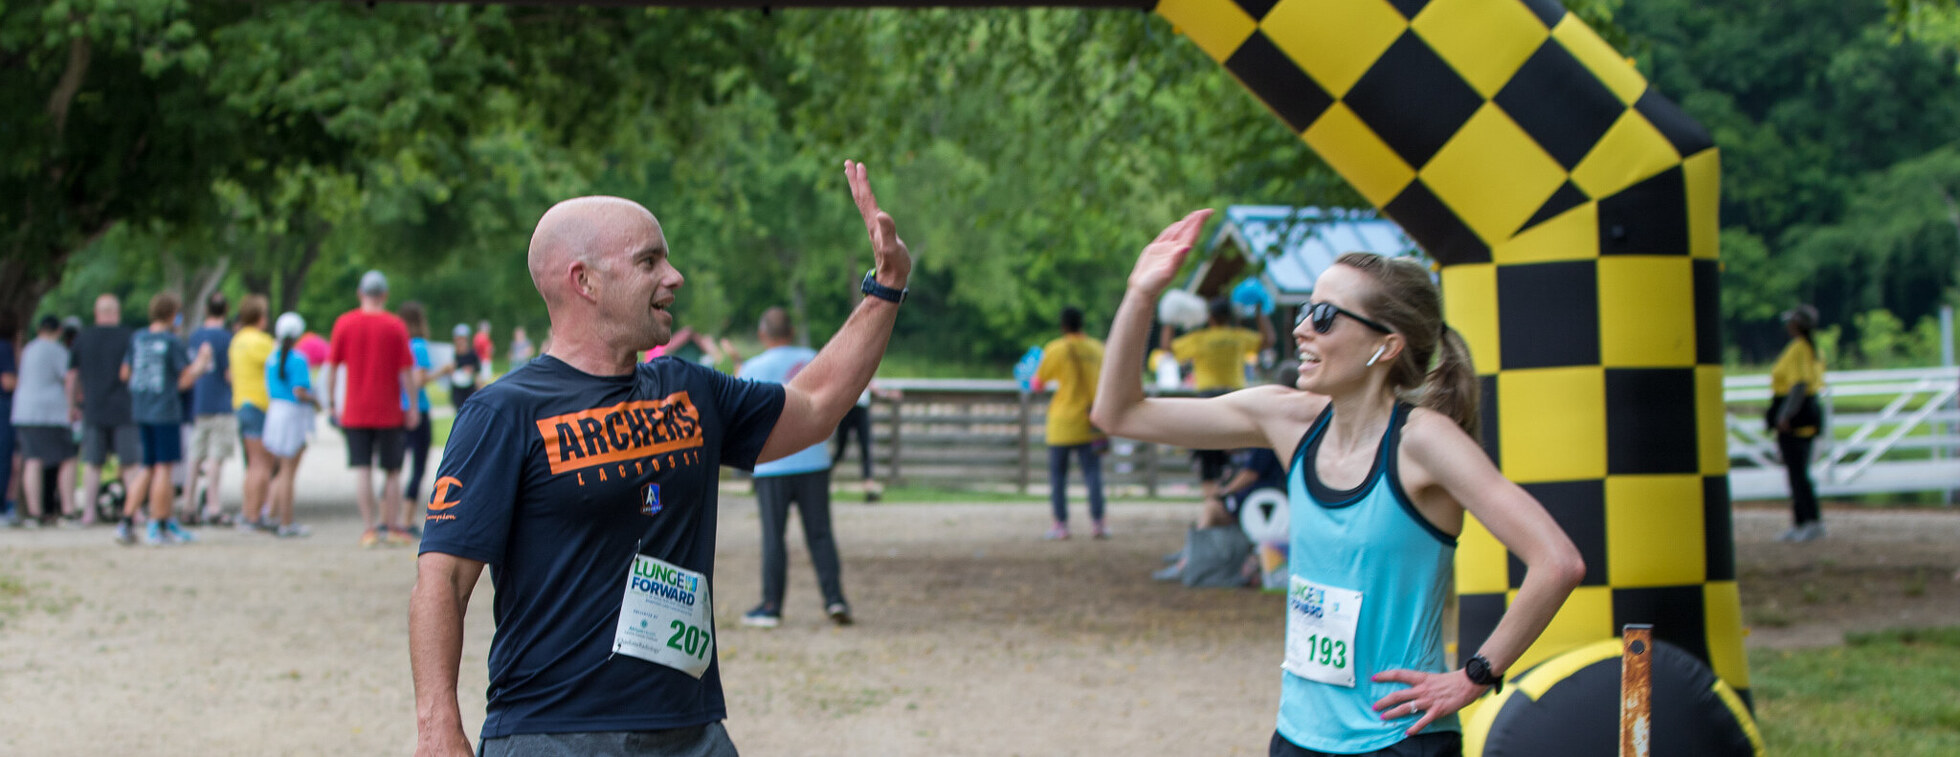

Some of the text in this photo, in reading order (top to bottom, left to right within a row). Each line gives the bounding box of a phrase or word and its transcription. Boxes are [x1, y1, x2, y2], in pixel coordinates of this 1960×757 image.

[556, 400, 697, 462] ARCHERS
[631, 576, 696, 607] FORWARD
[633, 560, 685, 589] LUNGE
[666, 619, 711, 661] 207
[1308, 633, 1347, 670] 193
